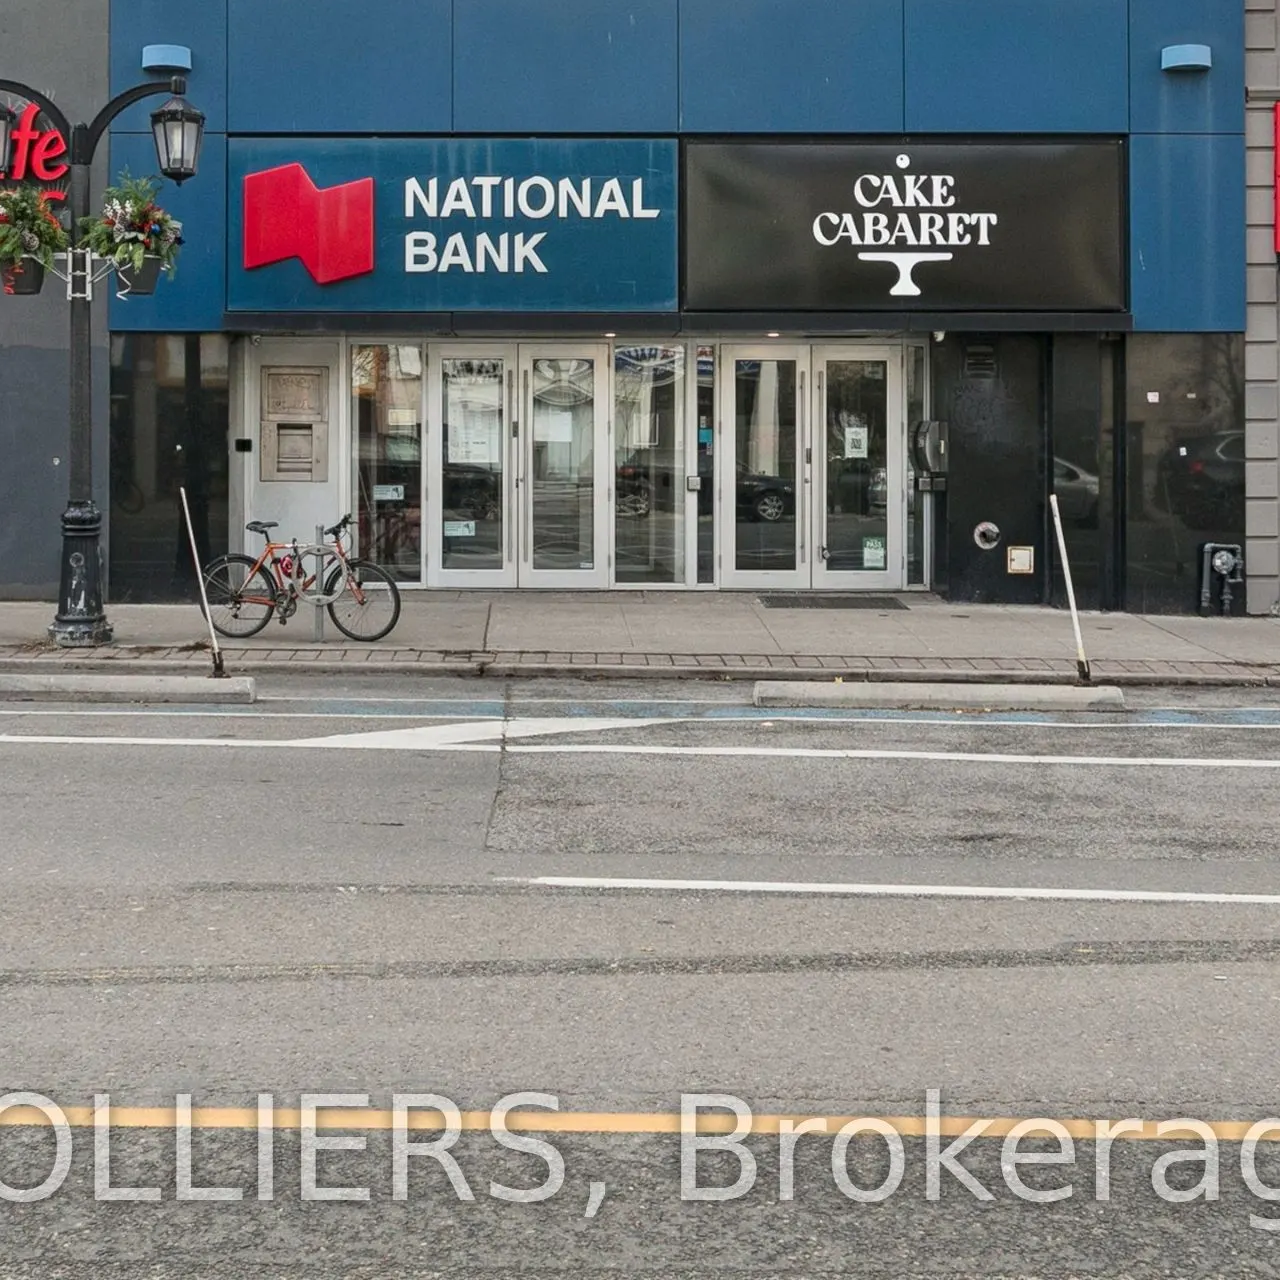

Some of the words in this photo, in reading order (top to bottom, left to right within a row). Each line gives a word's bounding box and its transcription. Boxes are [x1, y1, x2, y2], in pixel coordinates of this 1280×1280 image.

[404, 175, 661, 219] NATIONAL
[853, 174, 955, 208] CAKE
[812, 212, 997, 247] CABARET
[404, 231, 549, 273] BANK
